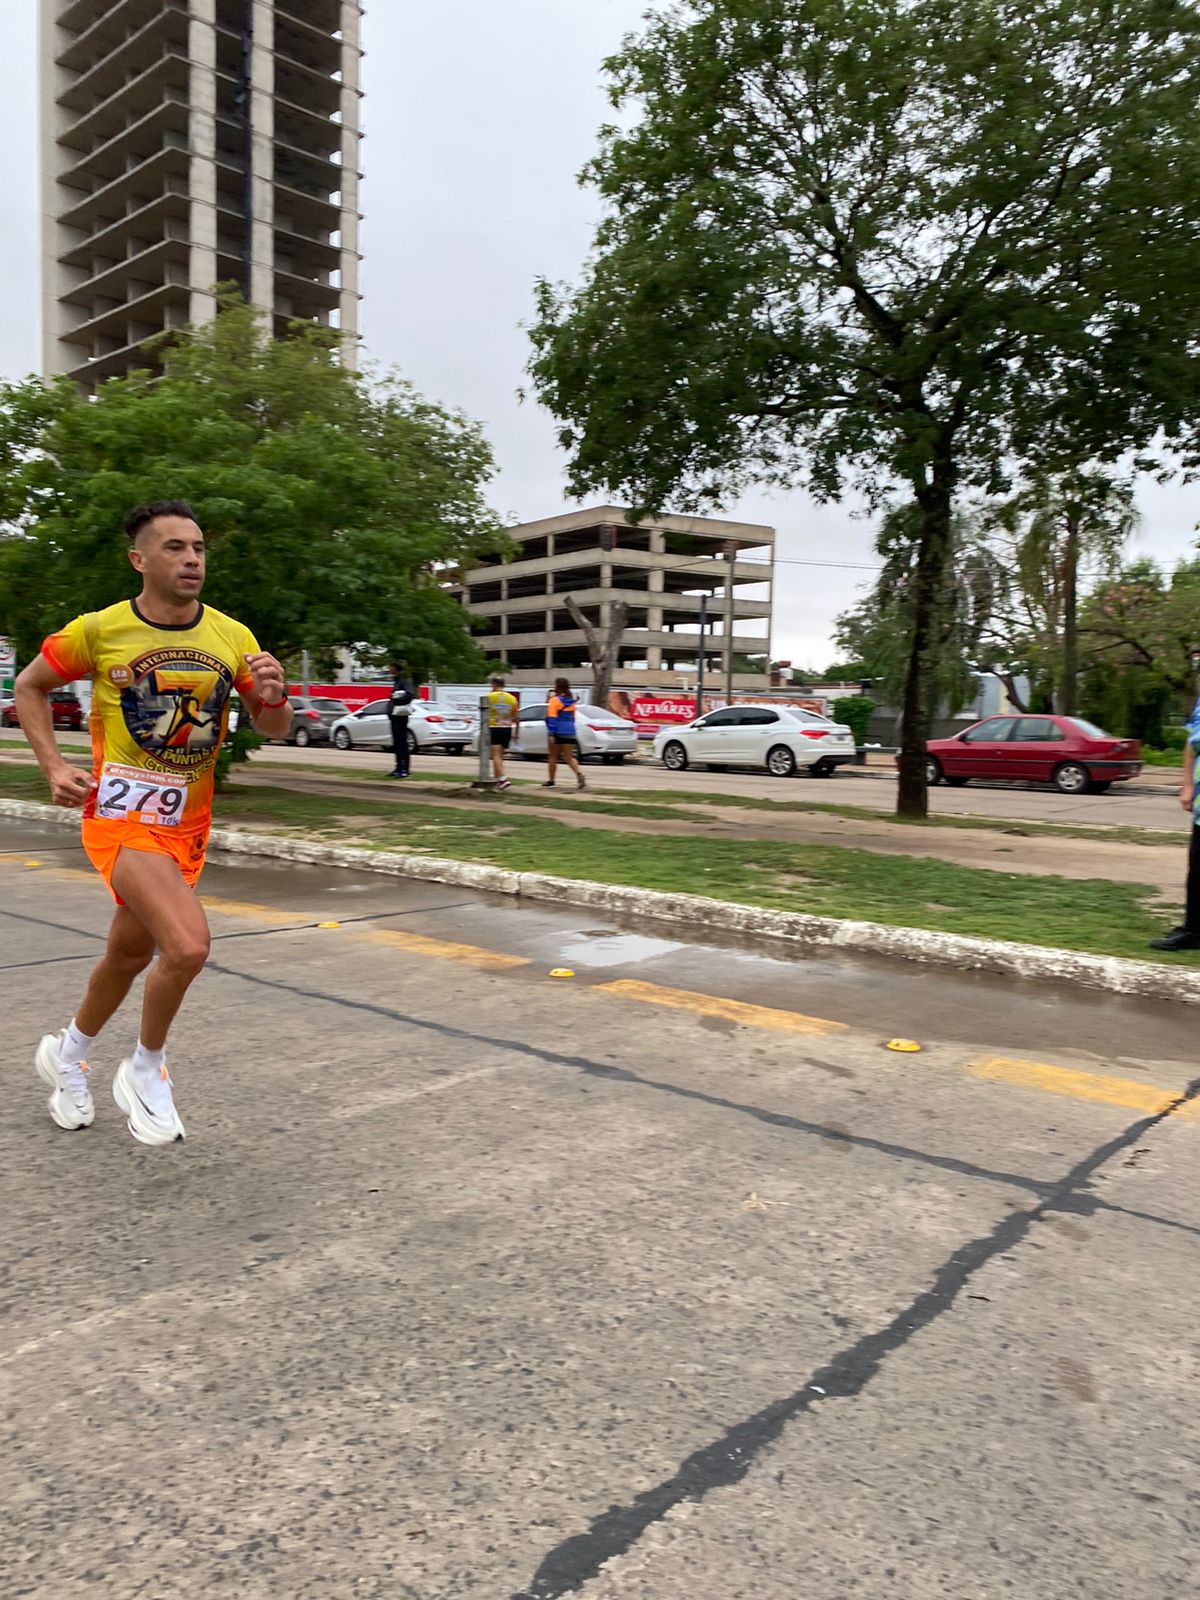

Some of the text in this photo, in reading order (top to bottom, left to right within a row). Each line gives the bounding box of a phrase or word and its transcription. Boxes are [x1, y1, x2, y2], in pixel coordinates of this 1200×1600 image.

[136, 651, 225, 675] INTERNACIONAL
[633, 701, 695, 718] NEVARES
[102, 778, 182, 816] 279
